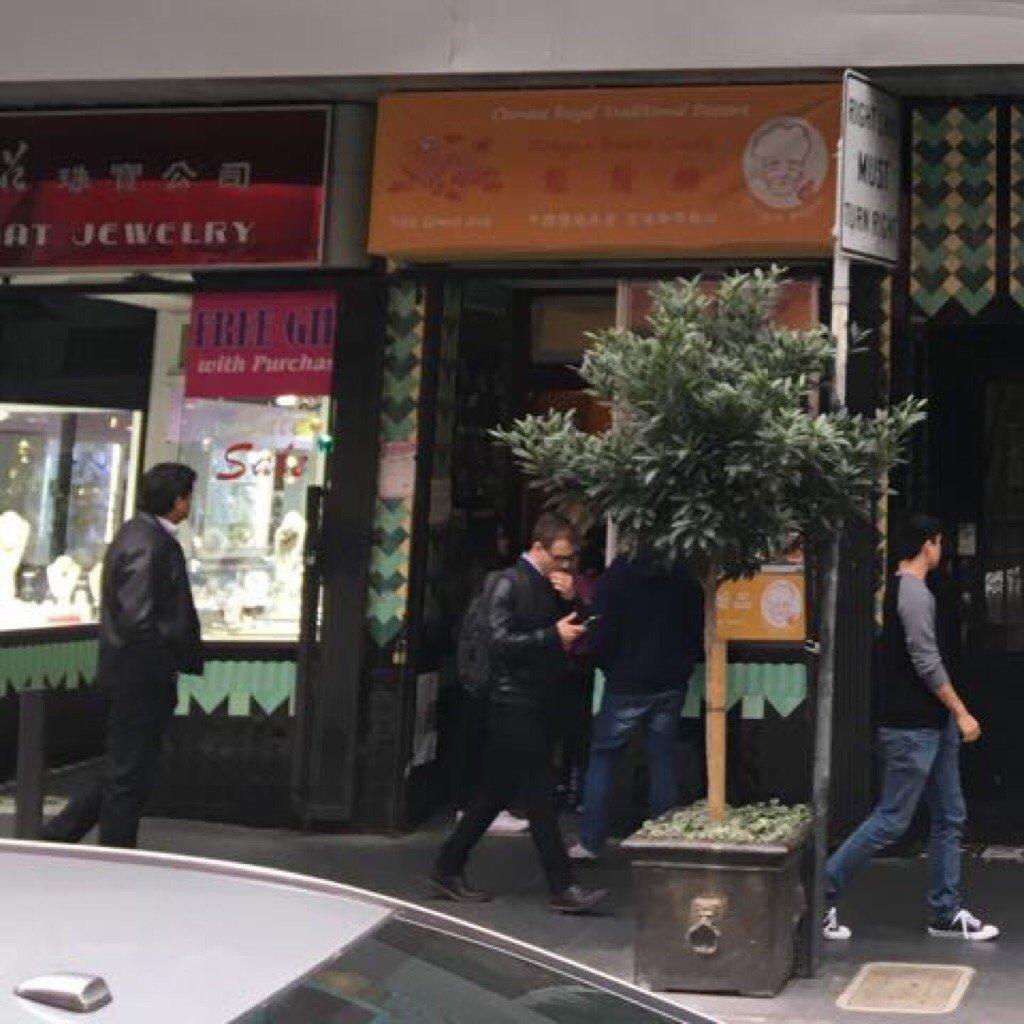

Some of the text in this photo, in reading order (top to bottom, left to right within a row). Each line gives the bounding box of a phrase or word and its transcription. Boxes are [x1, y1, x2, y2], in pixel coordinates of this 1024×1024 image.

[857, 150, 888, 190] MUST
[72, 222, 255, 246] JEWELRY
[195, 307, 275, 347] FREE
[199, 355, 246, 374] with
